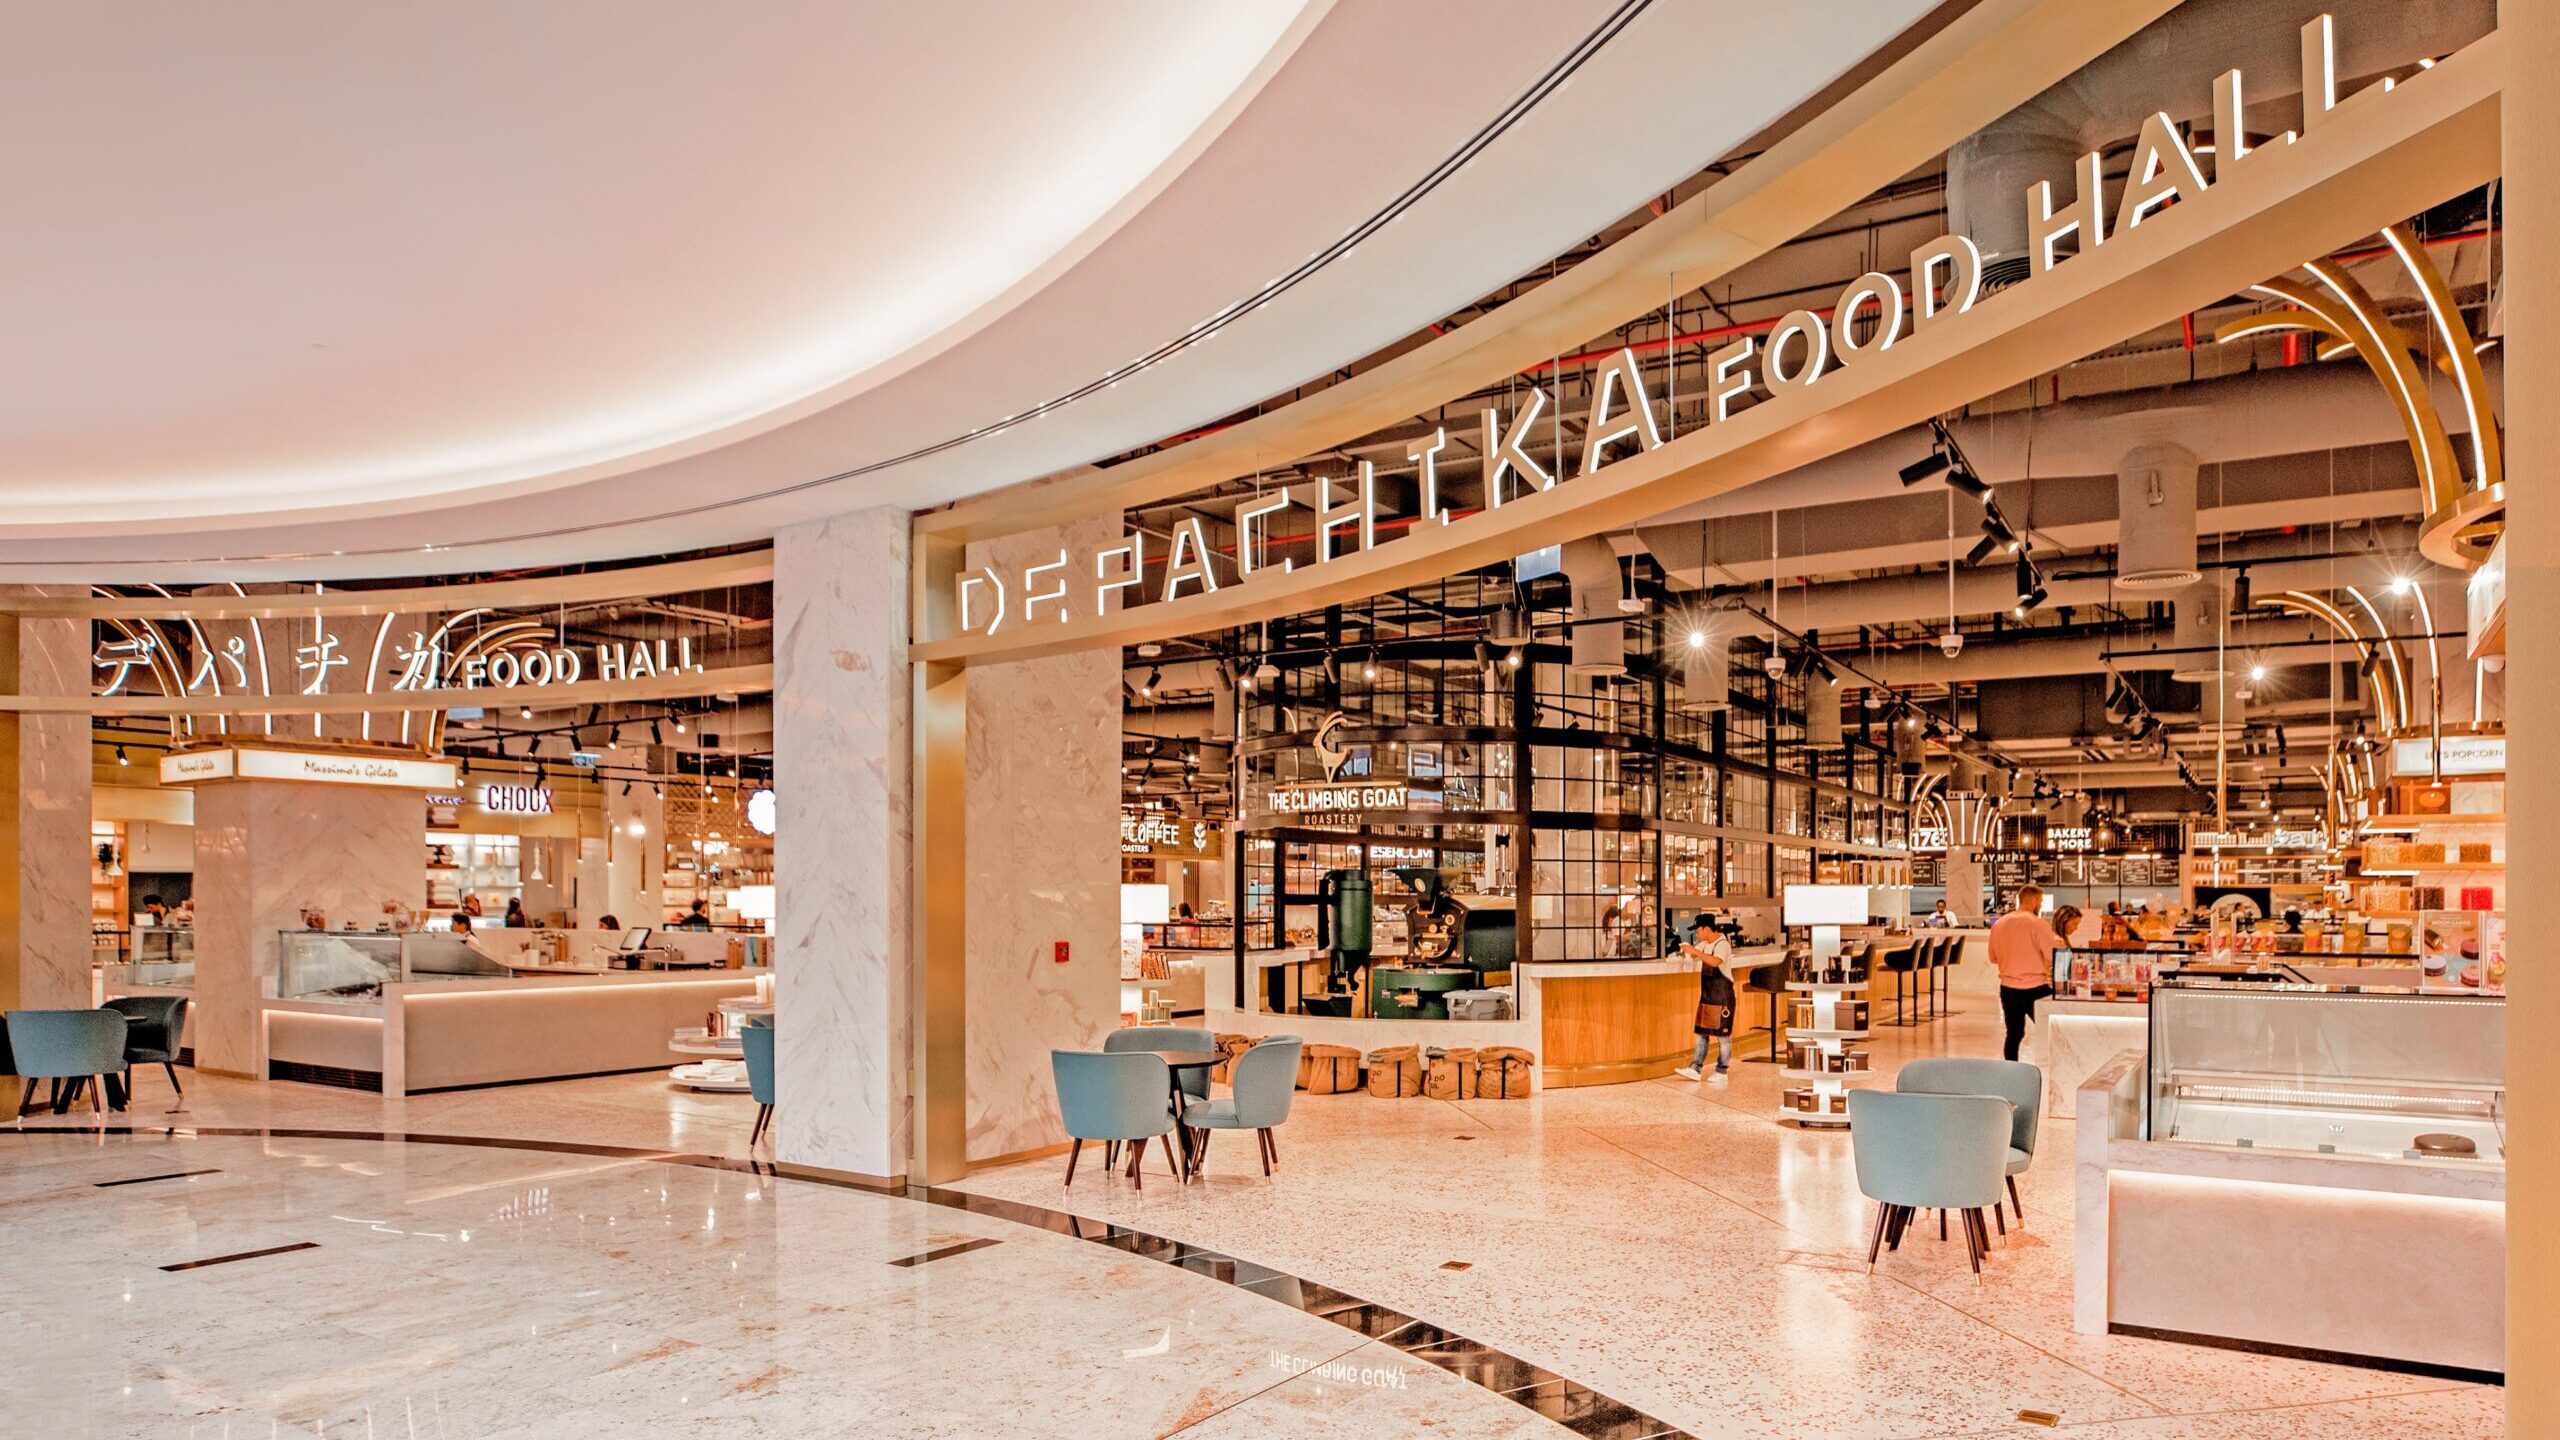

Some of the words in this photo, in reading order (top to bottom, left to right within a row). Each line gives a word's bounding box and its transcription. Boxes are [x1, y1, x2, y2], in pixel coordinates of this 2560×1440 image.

[956, 347, 1665, 637] DEPACHIKA
[1708, 233, 1982, 422] FOOD
[2027, 13, 2395, 272] HALL
[462, 648, 581, 690] FOOD
[597, 636, 704, 682] HALL
[2452, 748, 2504, 759] POPCORN
[303, 759, 361, 776] Massimo's
[364, 763, 399, 779] Gelato
[487, 785, 554, 813] CHOUX
[1268, 792, 1290, 811] THE
[1291, 789, 1359, 810] CLIMBING
[1362, 787, 1408, 808] GOAT
[1304, 812, 1363, 825] ROASTERY
[1128, 822, 1180, 846] COFFEE
[2046, 827, 2092, 839] BAKERY
[1120, 843, 1150, 853] OASTERS
[2058, 838, 2092, 850] MORE
[1974, 853, 1996, 862] PAY
[1997, 852, 2026, 862] HERE
